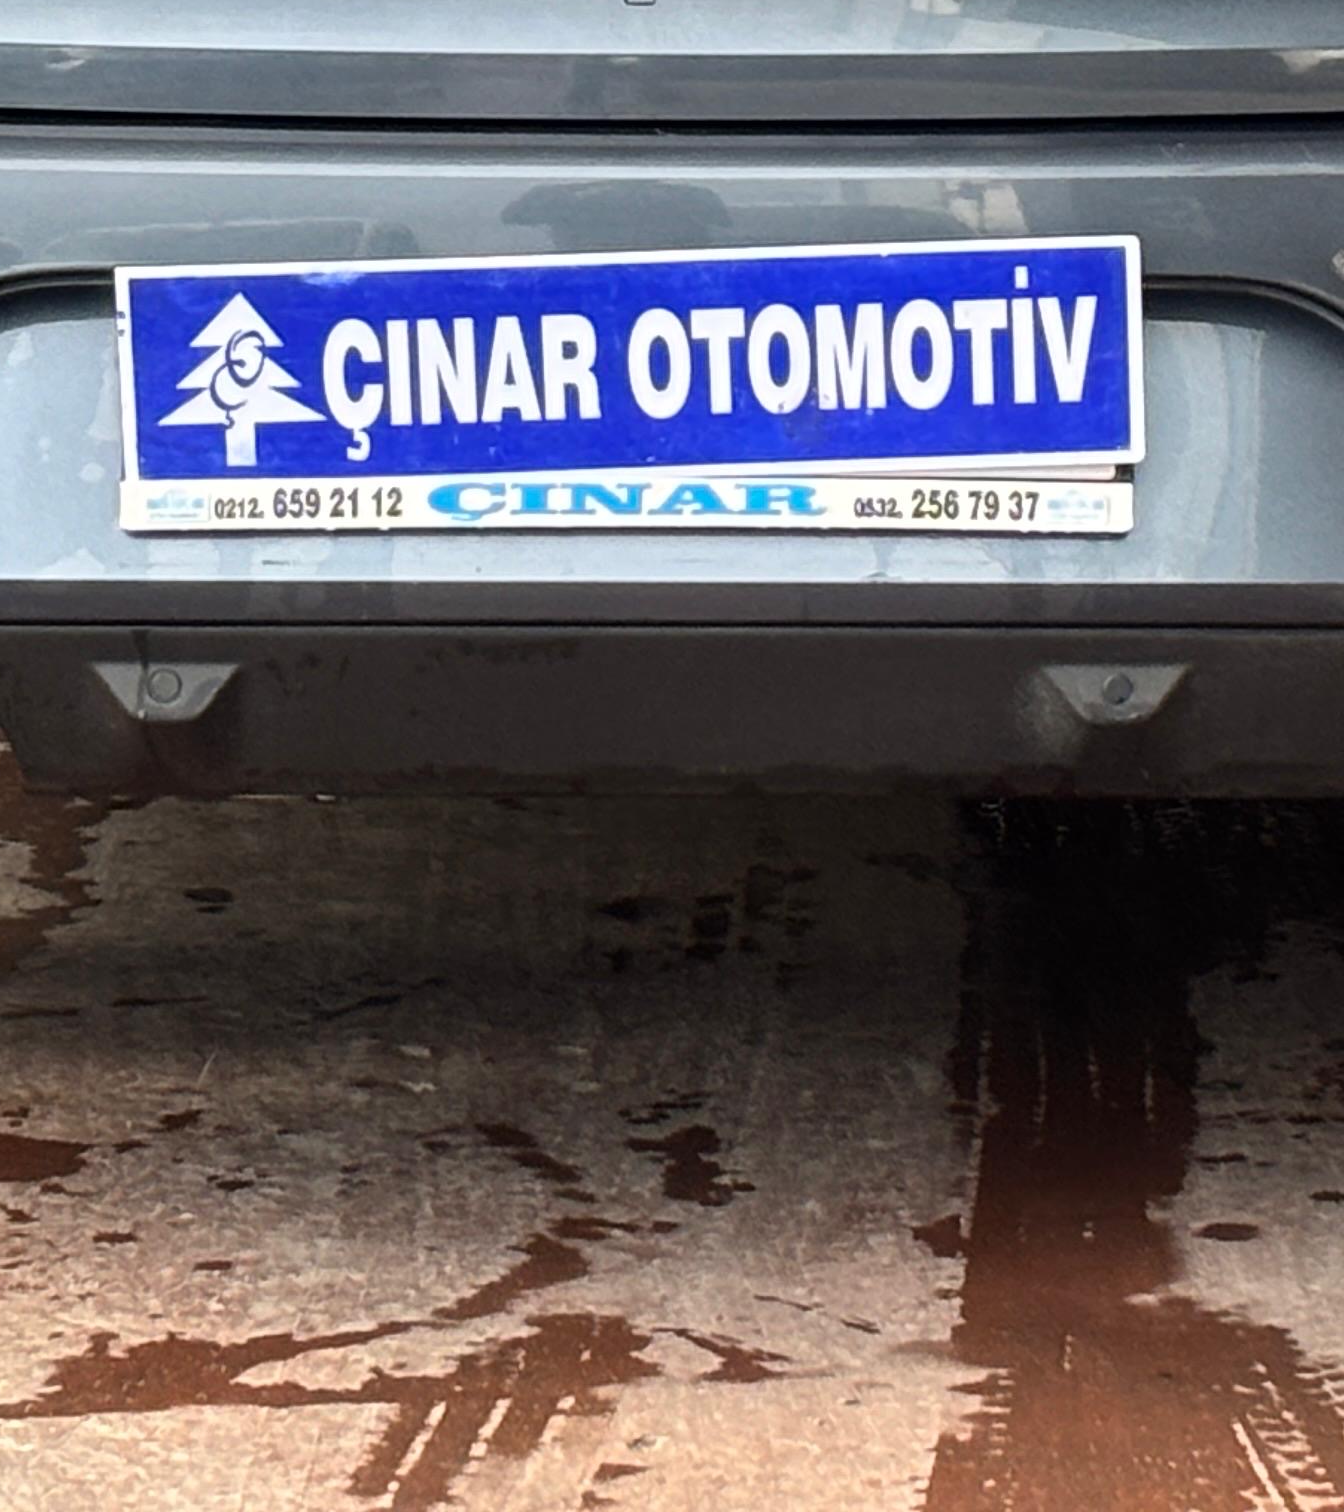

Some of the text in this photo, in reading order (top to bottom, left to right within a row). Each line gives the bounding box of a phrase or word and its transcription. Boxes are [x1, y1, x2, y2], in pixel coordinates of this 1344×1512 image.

[322, 265, 1098, 461] ÇINAR OTOMOTİV
[273, 486, 322, 519] 659
[329, 486, 359, 519] 21
[370, 486, 404, 518] 12
[427, 482, 828, 521] ÇINAR
[911, 488, 960, 520] 256
[967, 490, 1001, 521] 79
[1007, 491, 1040, 521] 37
